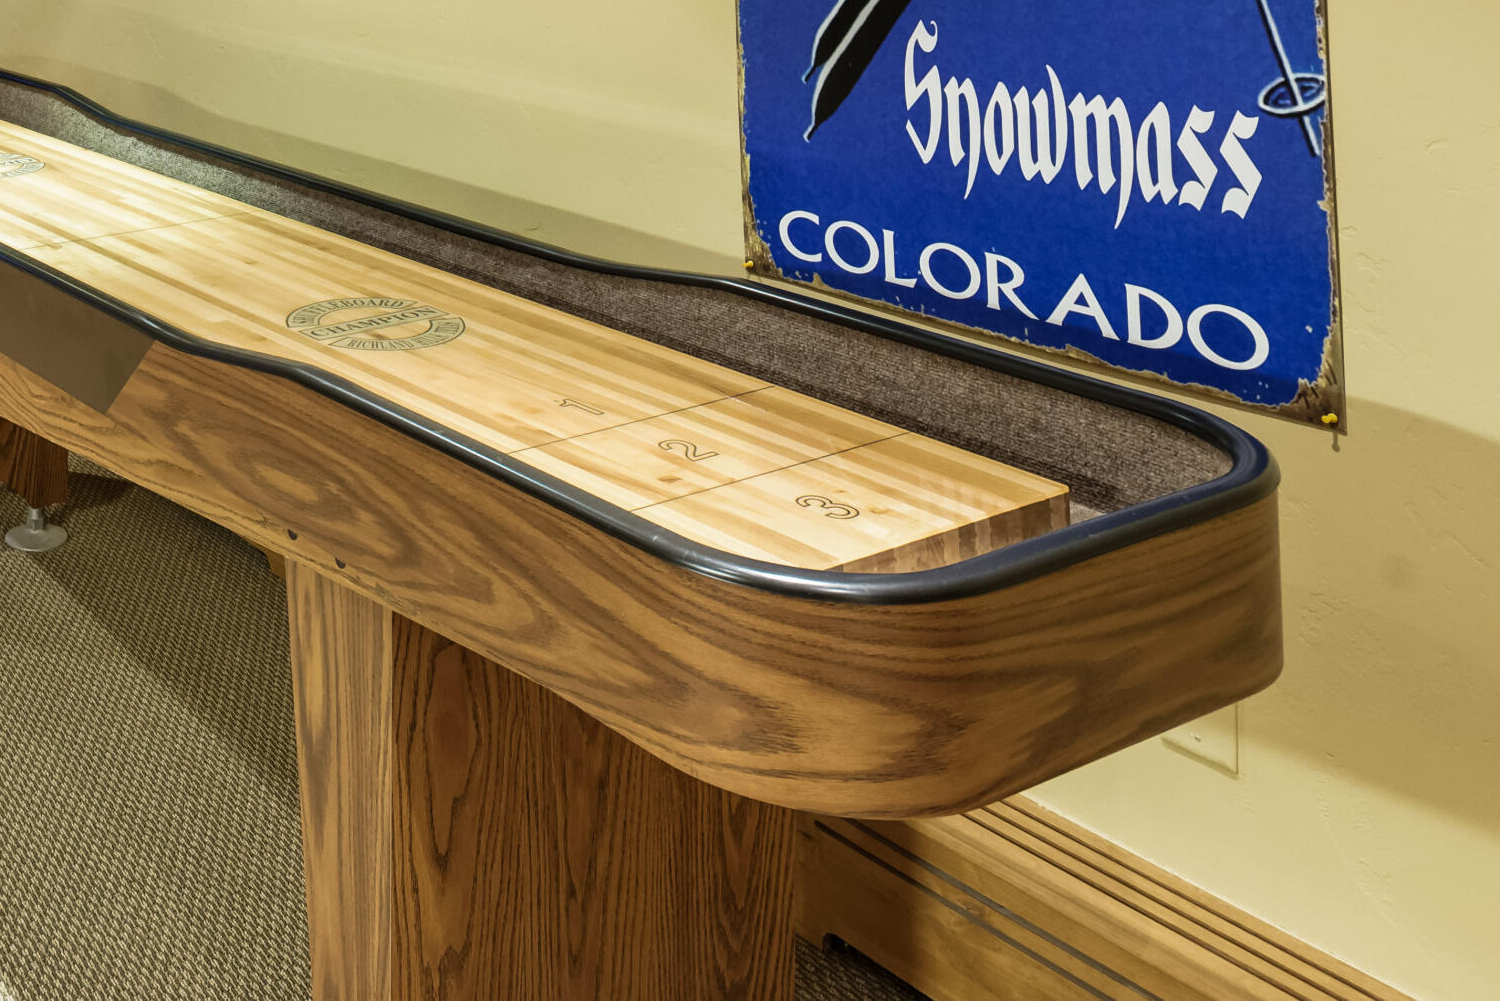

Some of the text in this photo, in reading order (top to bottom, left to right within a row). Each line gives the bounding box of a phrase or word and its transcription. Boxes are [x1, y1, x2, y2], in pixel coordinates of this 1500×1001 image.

[904, 19, 1263, 229] Snowmass
[778, 210, 1270, 371] COLORADO
[311, 307, 437, 337] CHAMPION
[556, 398, 605, 416] 1
[658, 439, 719, 462] 2
[795, 494, 861, 520] 3
